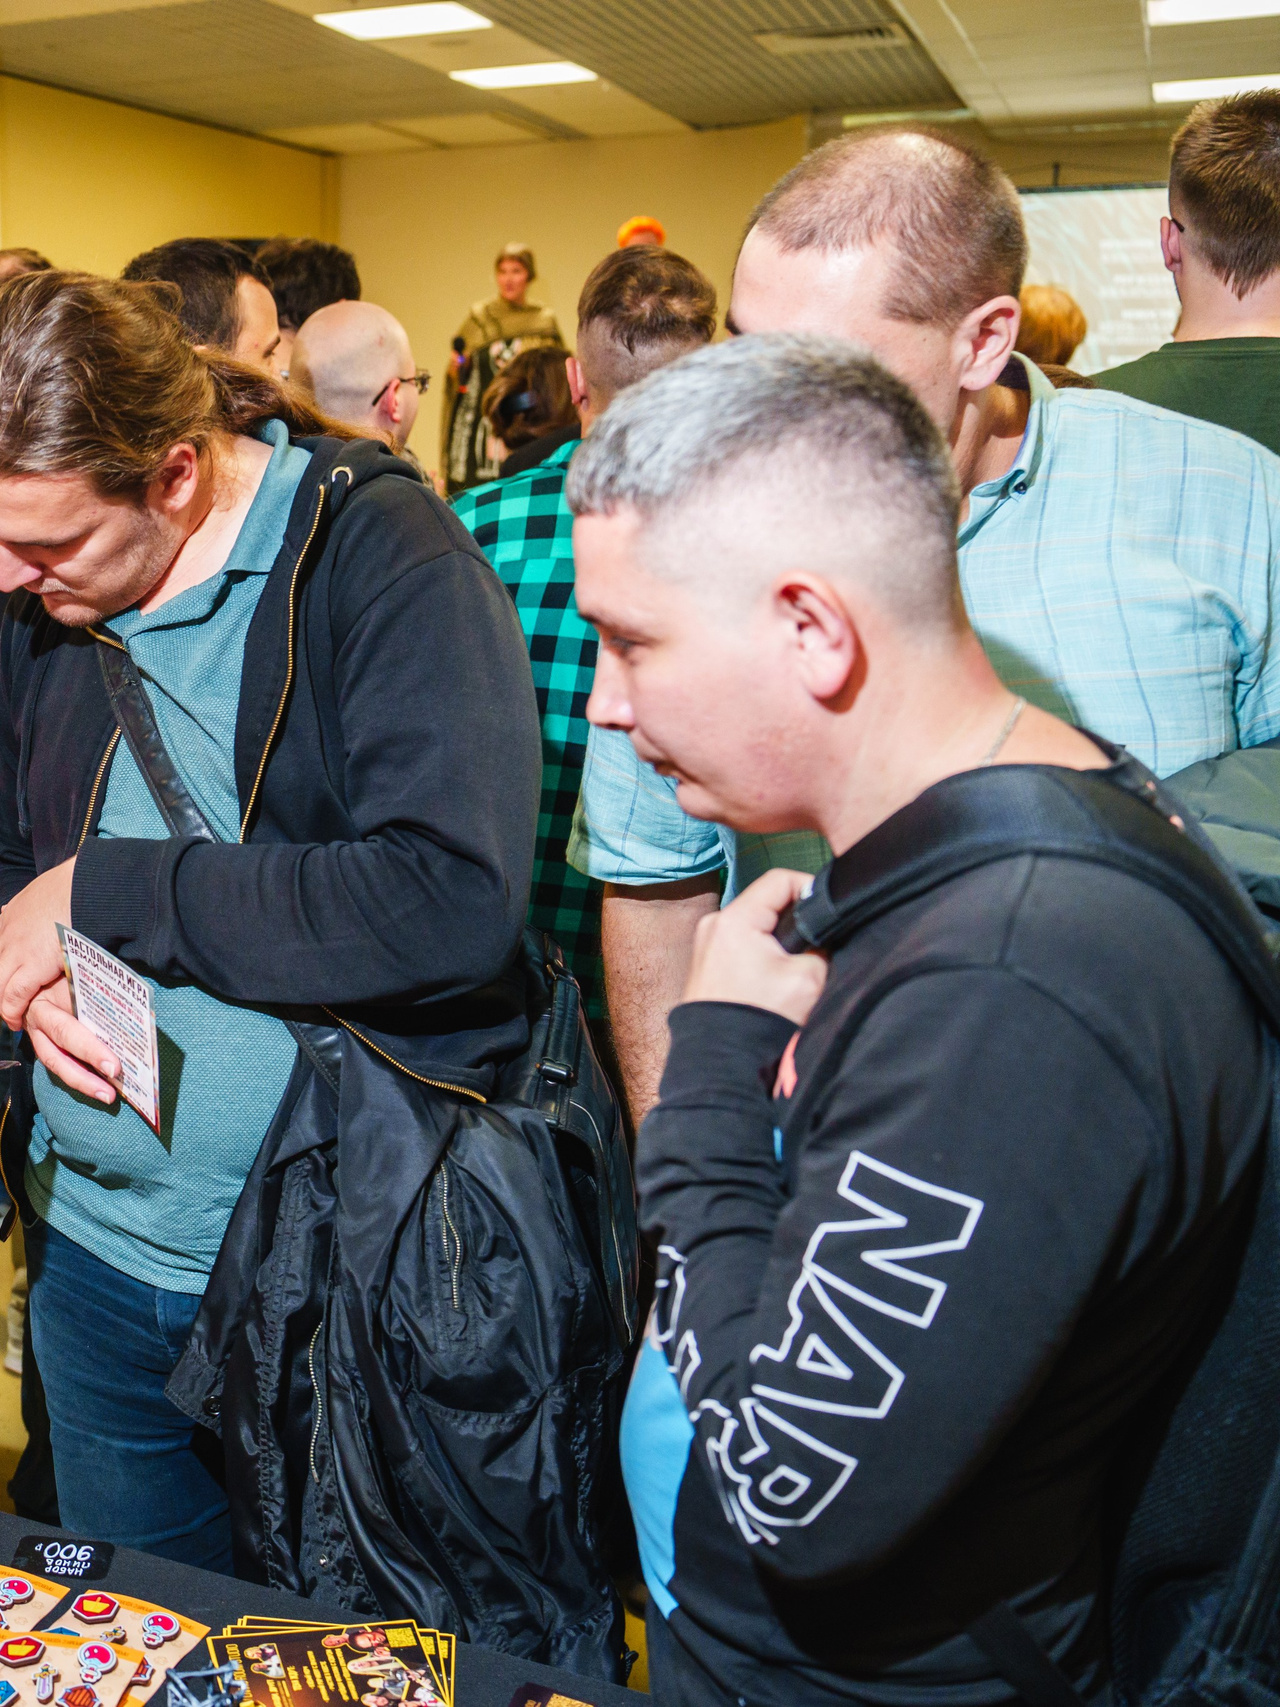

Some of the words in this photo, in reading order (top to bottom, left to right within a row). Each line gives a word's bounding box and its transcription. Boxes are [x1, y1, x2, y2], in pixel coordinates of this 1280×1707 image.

[67, 933, 124, 980] НАСТОЛЬНАЯ
[126, 973, 148, 1001] ИГРА
[69, 945, 99, 971] ЗЕМЛИ
[44, 1542, 94, 1561] 900
[45, 1565, 83, 1576] НАБОР
[46, 1558, 91, 1569] ПИНОВ
[225, 1643, 242, 1664] TUDIO
